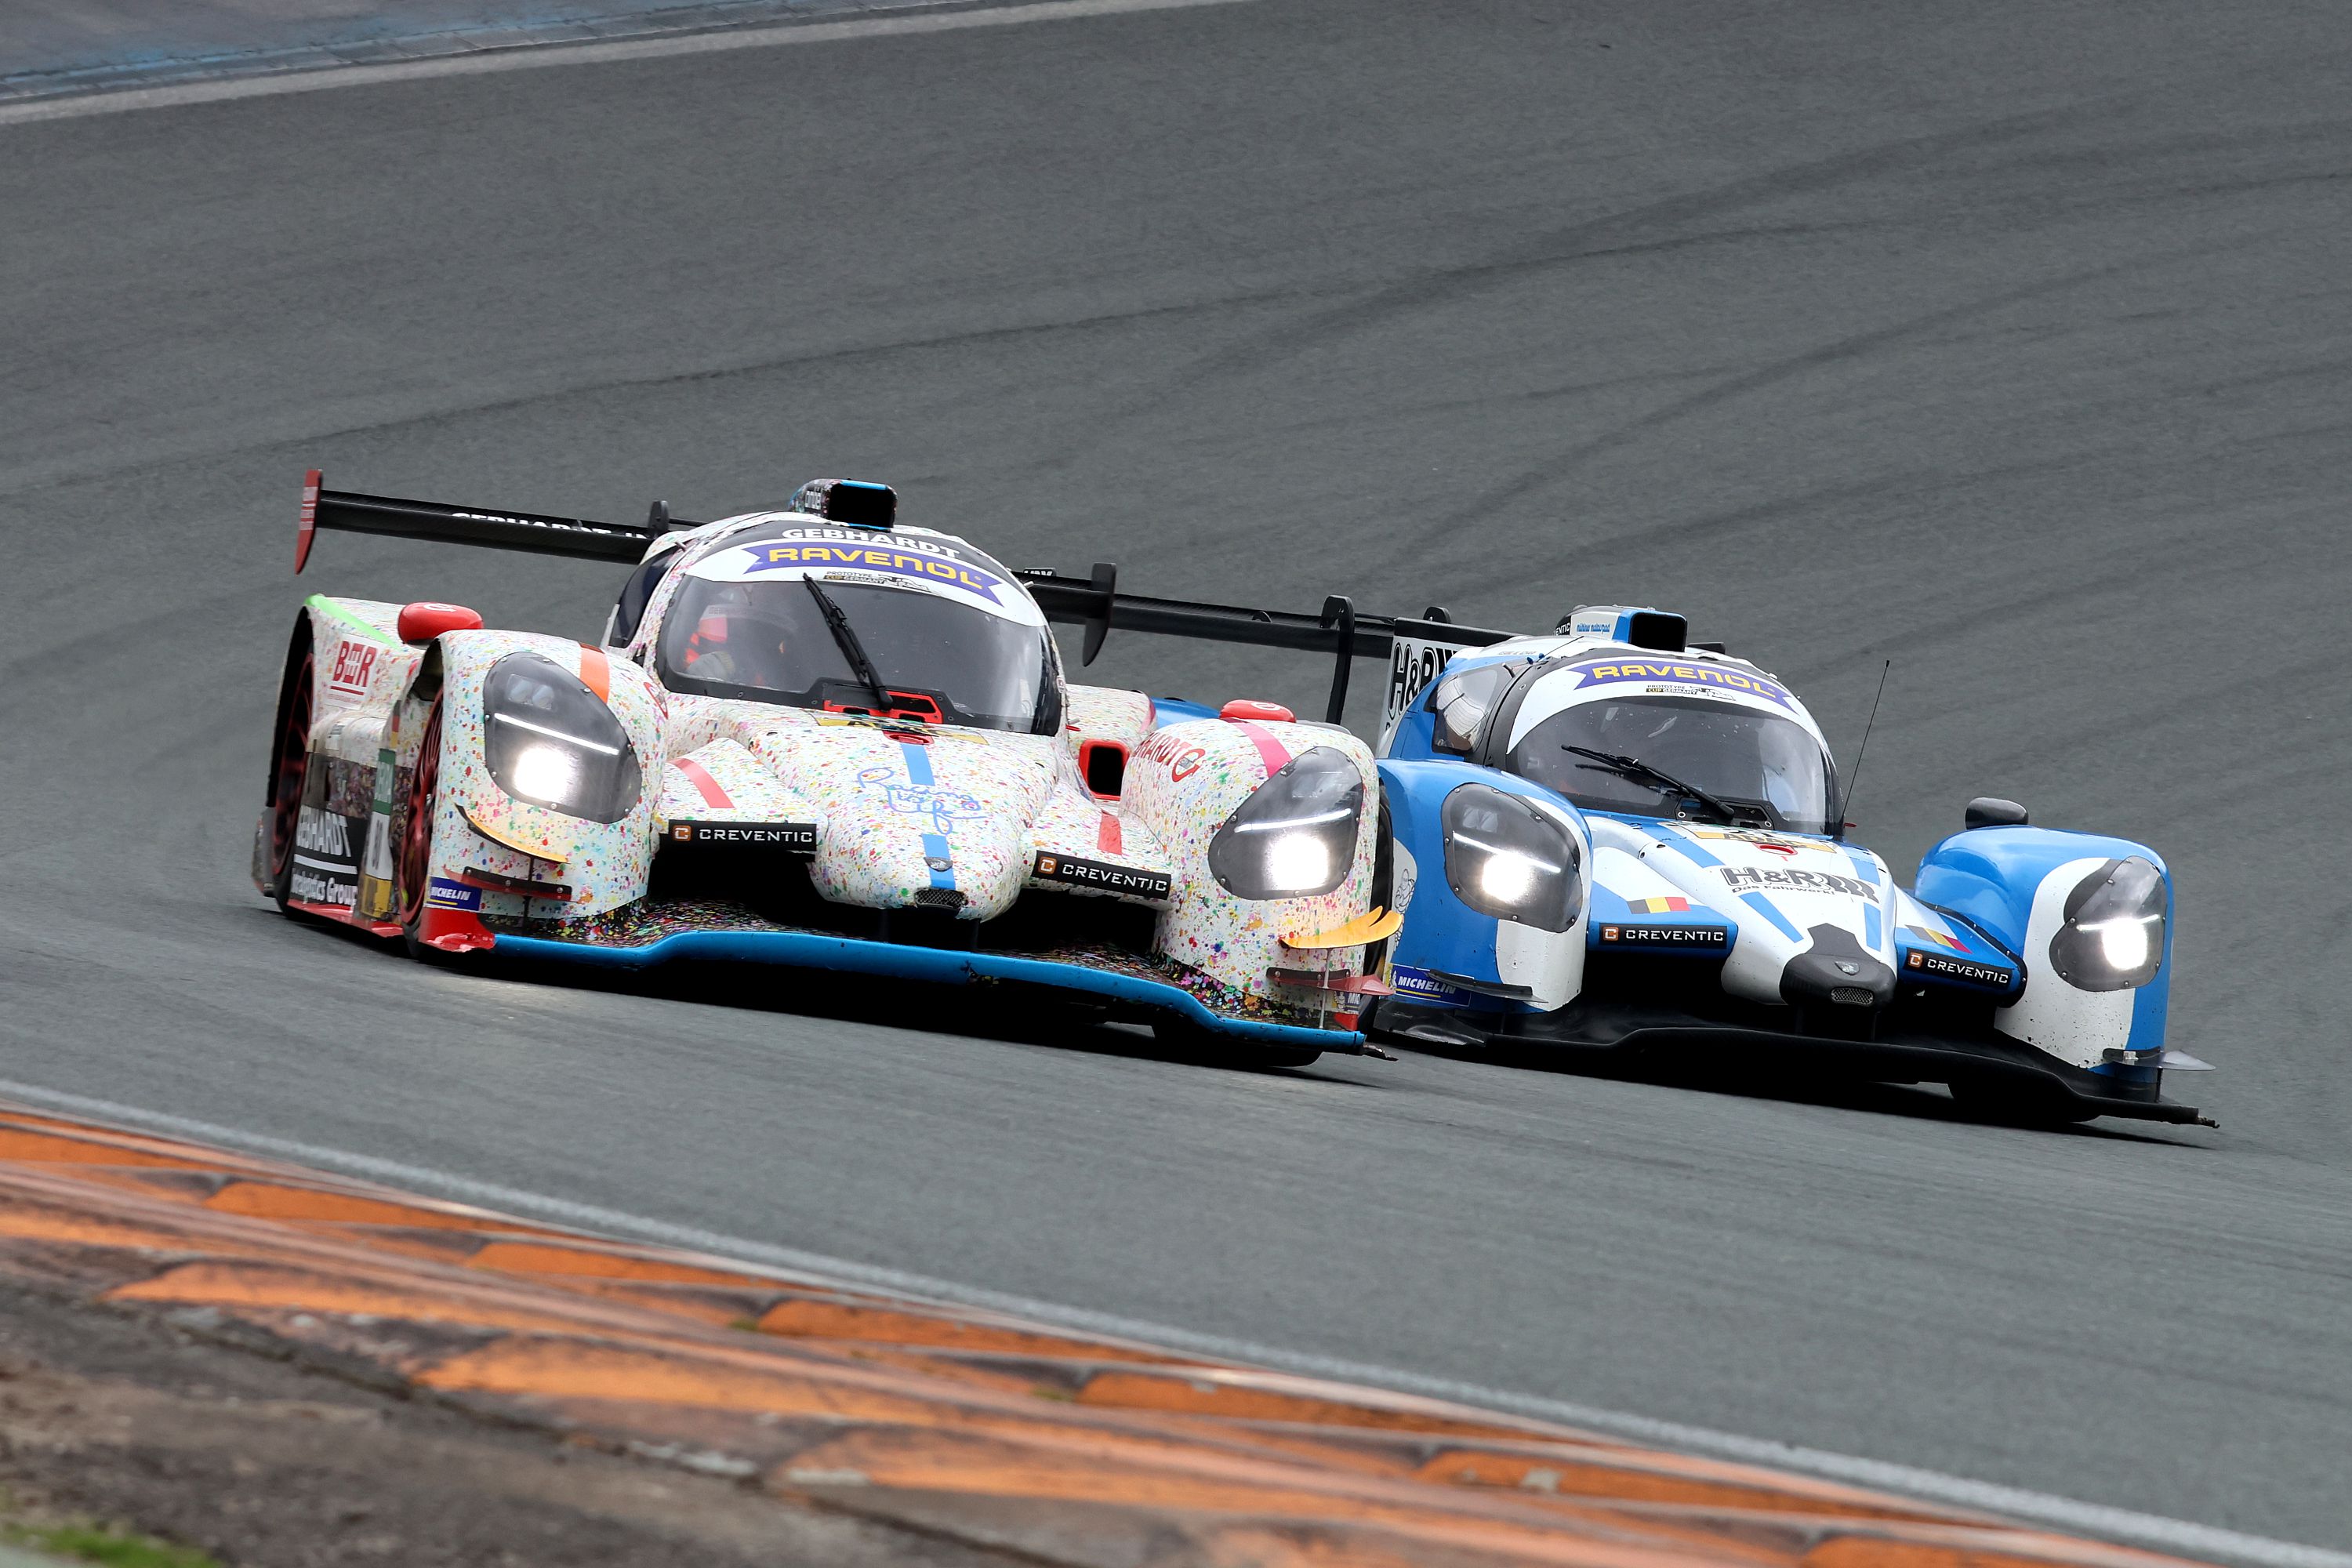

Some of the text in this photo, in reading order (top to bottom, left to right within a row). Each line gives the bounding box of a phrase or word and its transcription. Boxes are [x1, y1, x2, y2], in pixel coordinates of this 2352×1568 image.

[782, 528, 960, 559] GEBHARDT
[768, 547, 982, 590] RAVENOL
[1592, 665, 1776, 699] RAVENOL
[699, 829, 813, 843] CREVENTIC
[1062, 864, 1167, 892] CREVENTIC
[1625, 930, 1724, 942] CREVENTIC
[1927, 958, 2009, 984] CREVENTIC
[1398, 975, 1457, 995] MICHELIN
